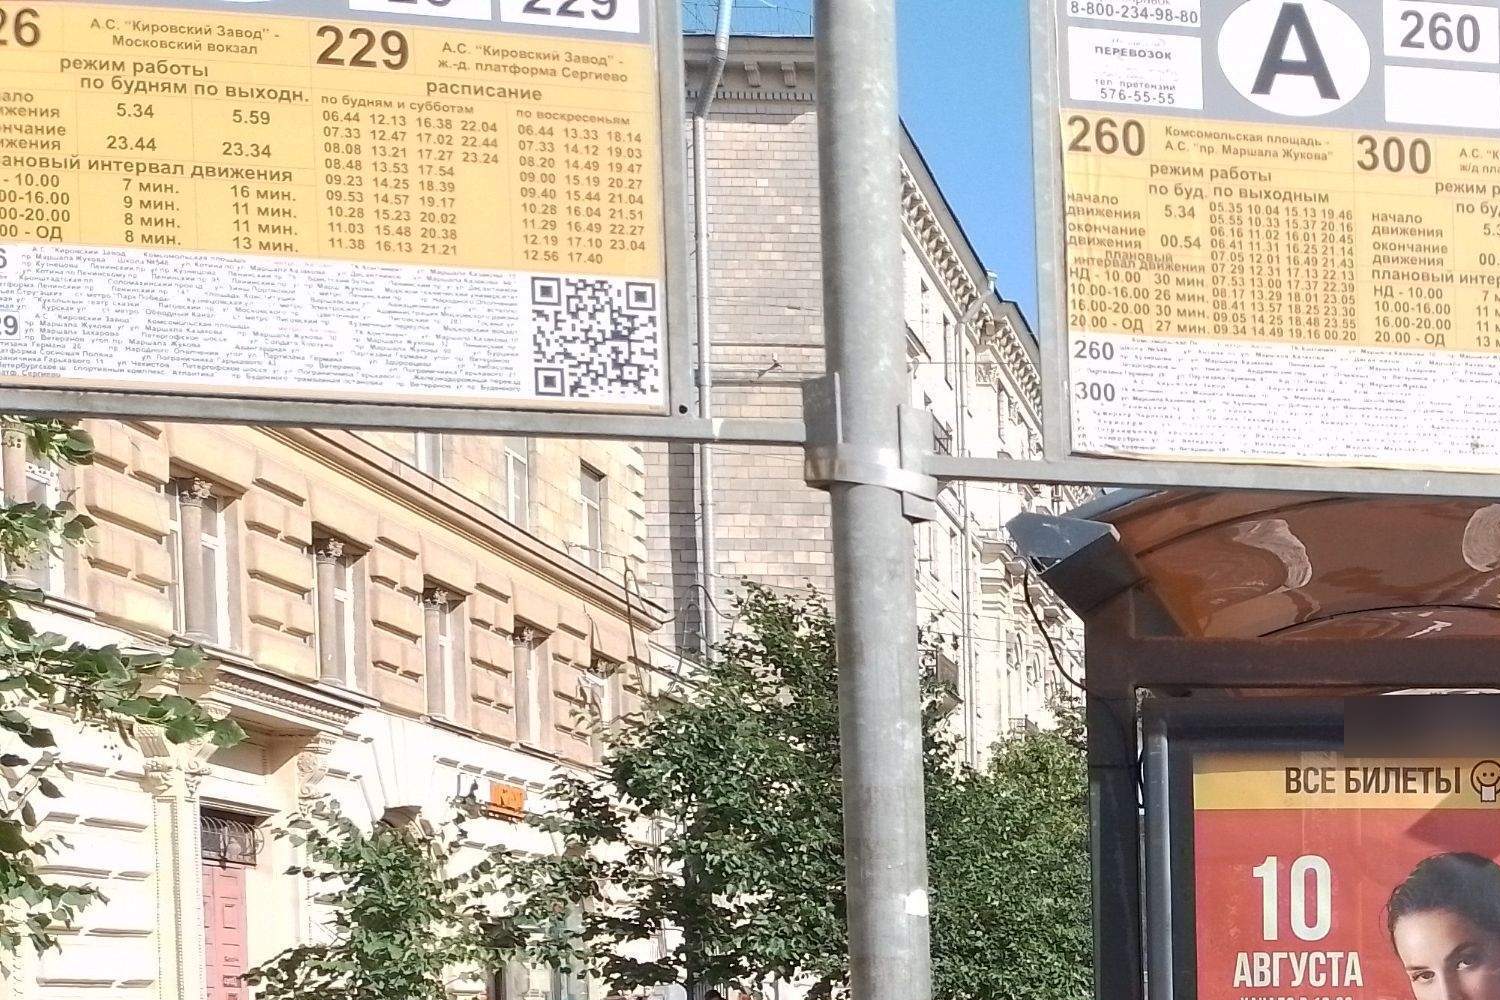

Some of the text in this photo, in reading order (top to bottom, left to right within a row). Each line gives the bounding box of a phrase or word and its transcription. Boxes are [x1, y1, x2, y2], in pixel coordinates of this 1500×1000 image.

[1069, 2, 1198, 25] 8-800-234-98-80
[217, 25, 270, 40] Завод"
[1400, 10, 1480, 53] 260
[112, 35, 258, 55] Московский вокзал
[316, 24, 409, 71] 229
[1095, 46, 1172, 60] ПЕРЕВОЗОК
[60, 57, 209, 77] режим работы
[564, 51, 614, 66] Завод"
[475, 62, 557, 78] платформа
[561, 66, 628, 83] Сергиево
[80, 76, 309, 104] по будням по выходн.
[426, 81, 543, 103] расписание
[1099, 88, 1175, 106] 576-55-55
[117, 102, 154, 119] 5.34
[321, 94, 474, 114] по будням и субботам
[232, 109, 271, 125] 5.59
[322, 110, 498, 133] 06.44 12.13 16.38 22.04
[516, 109, 630, 126] по воскресеньям
[517, 124, 554, 137] 06.44
[563, 128, 599, 141] 13.33
[1067, 115, 1145, 157] 260
[1165, 125, 1322, 148] Комсомольская площадь
[107, 135, 157, 152] 23.44
[222, 142, 271, 159] 23.34
[1222, 144, 1279, 159] Маршала
[1282, 148, 1333, 162] Жукова"
[1356, 134, 1432, 175] 300
[88, 159, 184, 176] интервал
[191, 165, 293, 182] движения
[1150, 163, 1272, 182] режим работы
[1459, 163, 1479, 175] ж/д
[1148, 184, 1168, 196] по
[1213, 186, 1233, 198] по
[1239, 187, 1329, 204] выходным
[1435, 181, 1486, 198] режим
[1209, 201, 1353, 222] 05.35 10.04 15.13 19.46
[1456, 202, 1475, 214] по
[1371, 211, 1423, 224] начало
[1371, 225, 1443, 238] движения
[1372, 240, 1448, 254] окончание
[1372, 254, 1444, 267] движения
[1371, 268, 1454, 284] плановый
[1374, 300, 1451, 316] 10.00-16.00
[1475, 305, 1489, 318] 11
[1375, 315, 1451, 331] 16.00-20.00
[1476, 320, 1489, 333] 11
[1074, 339, 1115, 361] 260
[1075, 381, 1116, 402] 300
[1284, 765, 1337, 795] ВСЕ
[1344, 765, 1462, 795] БИЛЕТЫ
[1252, 854, 1332, 942] 10
[1233, 951, 1364, 988] АВГУСТА
